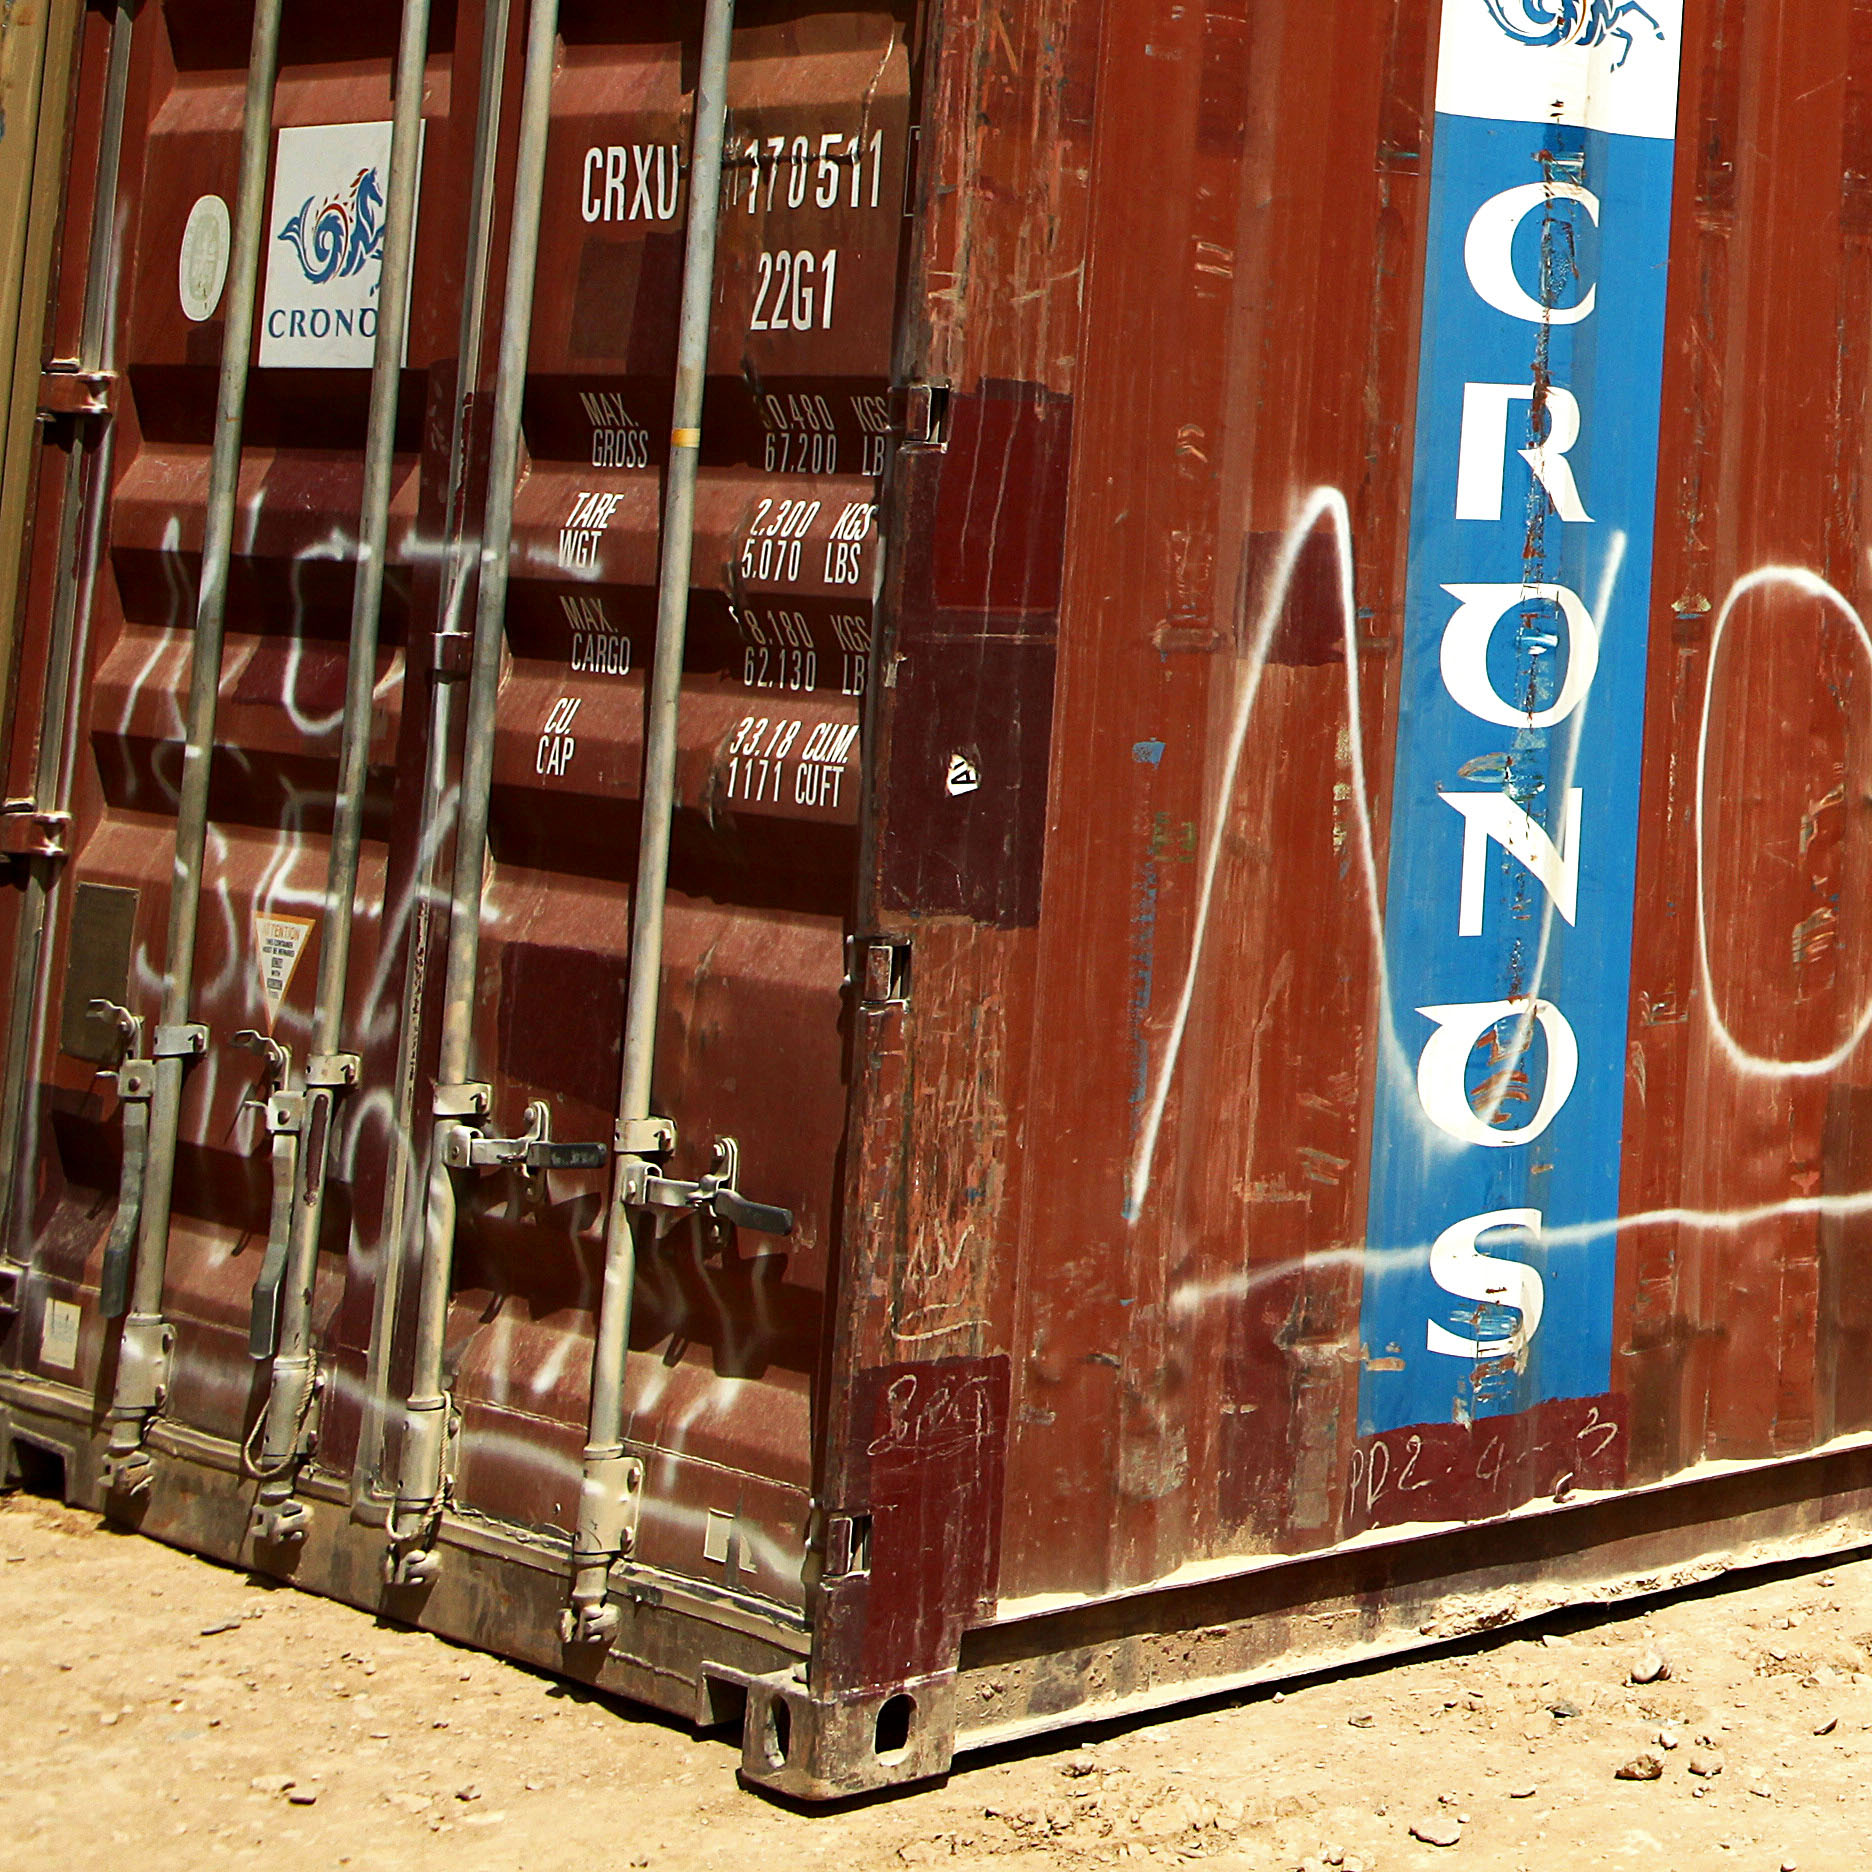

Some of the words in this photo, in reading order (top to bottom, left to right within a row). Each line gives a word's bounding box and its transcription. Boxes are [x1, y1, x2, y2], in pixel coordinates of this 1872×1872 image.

[581, 144, 678, 223] CRXU
[744, 128, 883, 214] 170511
[750, 249, 837, 330] 22G1
[268, 308, 379, 339] CRONO
[579, 392, 639, 427] MAX.
[753, 394, 834, 431] 0.480
[592, 429, 648, 469] GROSS
[565, 492, 625, 529] TARE
[830, 502, 878, 542] KGS
[557, 528, 602, 569] WGT
[824, 542, 861, 585] LBS
[559, 596, 619, 633] MAX.
[571, 632, 631, 676] CARGO
[543, 697, 582, 735] CU.
[536, 735, 575, 776] CAP
[729, 716, 801, 760] 33.18
[727, 756, 783, 803] 1171
